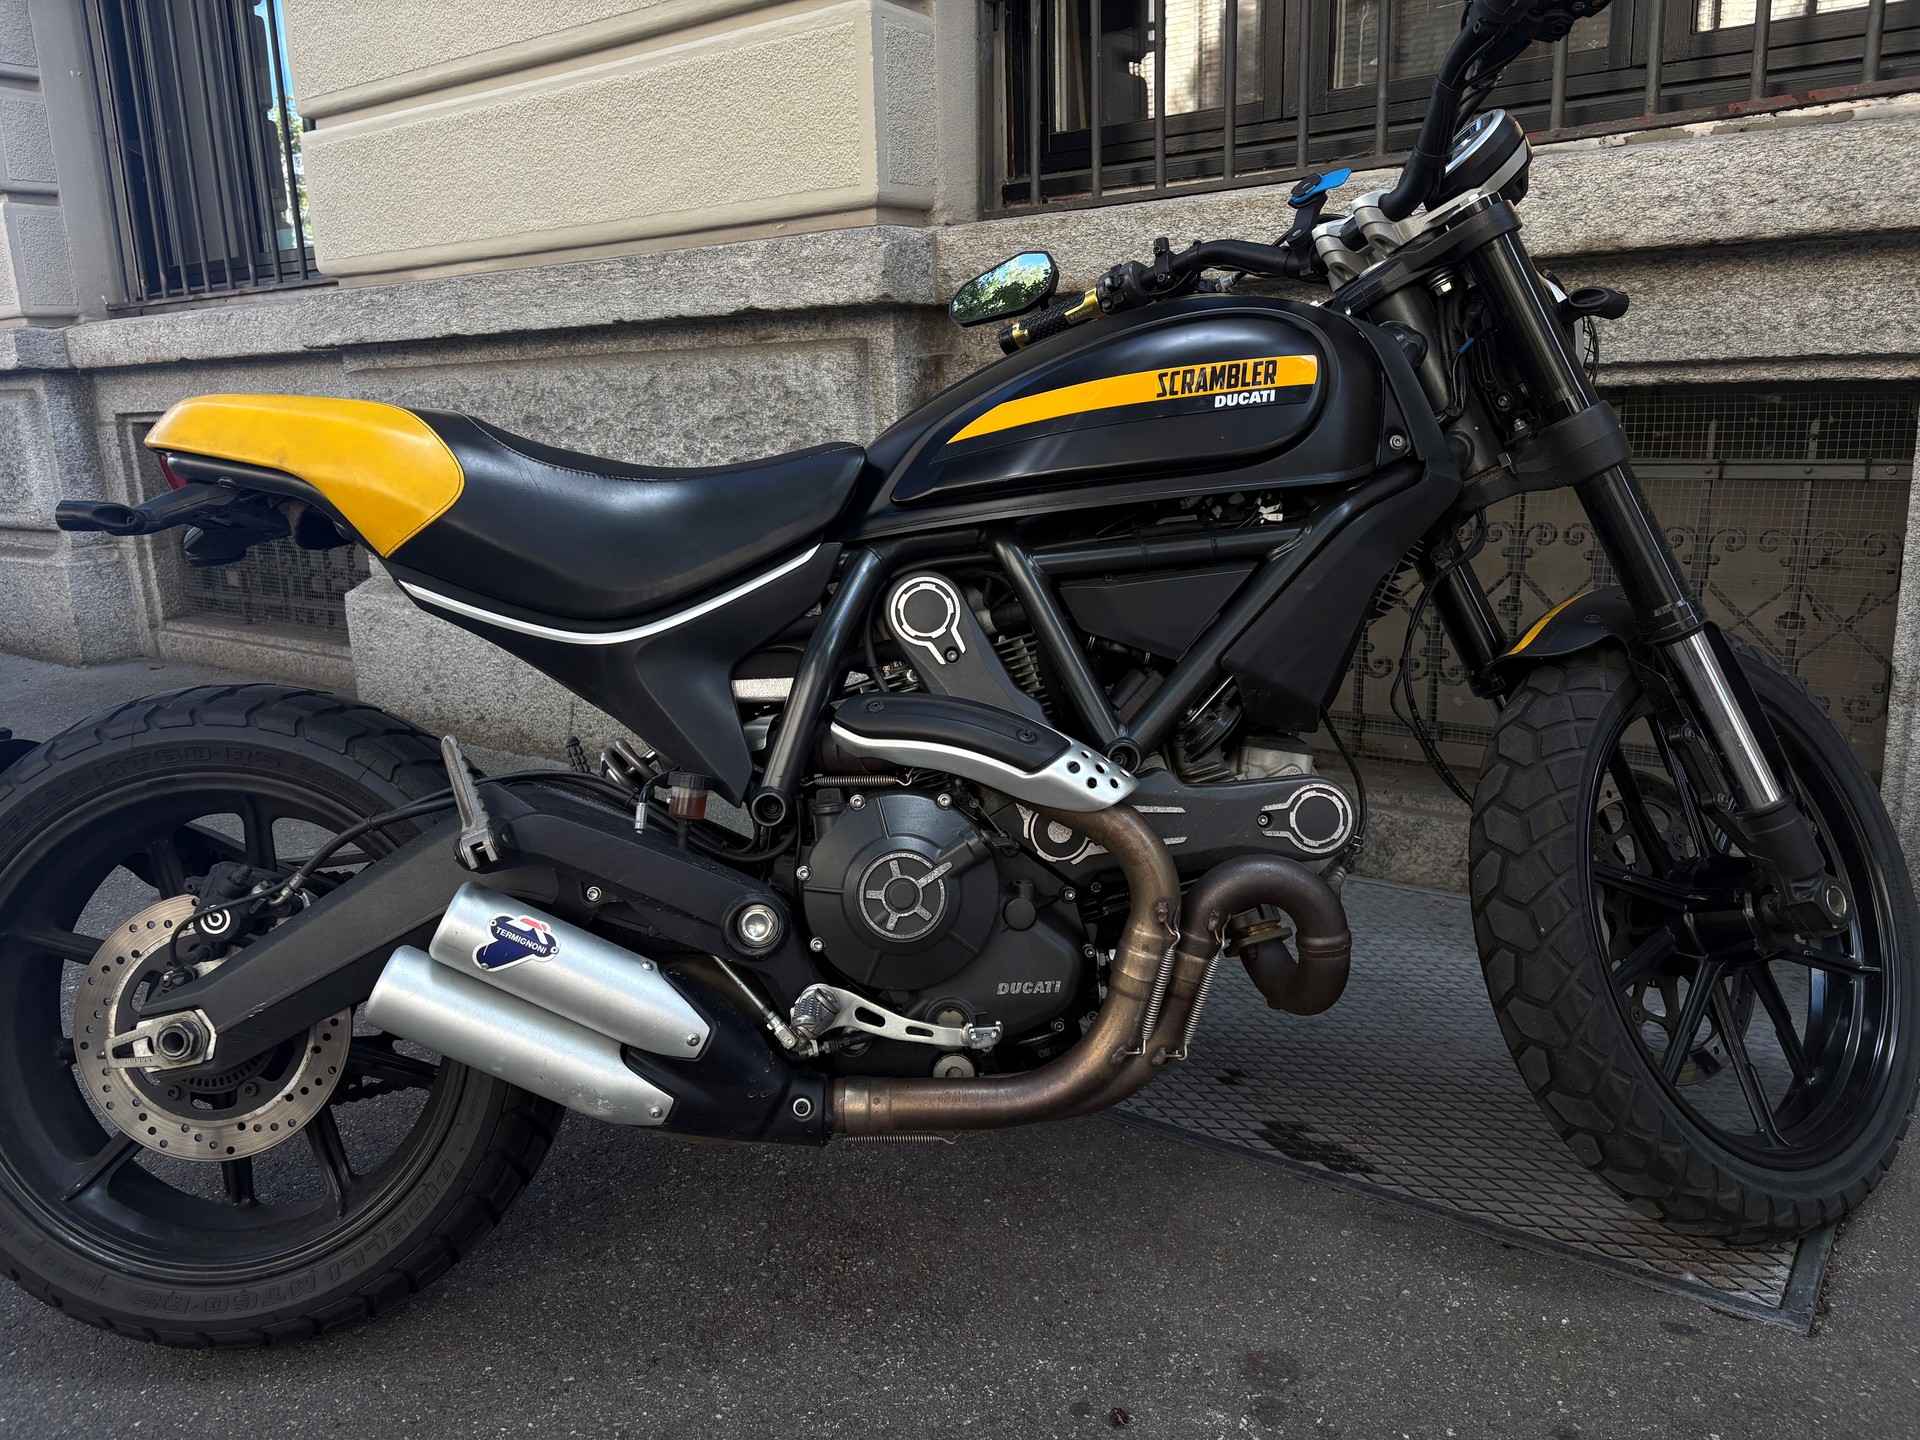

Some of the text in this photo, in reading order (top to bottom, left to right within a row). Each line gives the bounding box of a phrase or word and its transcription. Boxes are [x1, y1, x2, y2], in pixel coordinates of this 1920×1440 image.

[1156, 359, 1278, 398] SCRAMBLER
[1214, 389, 1276, 409] DUCATI
[495, 926, 548, 955] TERMIGNONI
[996, 980, 1062, 996] DUCATI
[328, 1158, 456, 1283] PIRELLI
